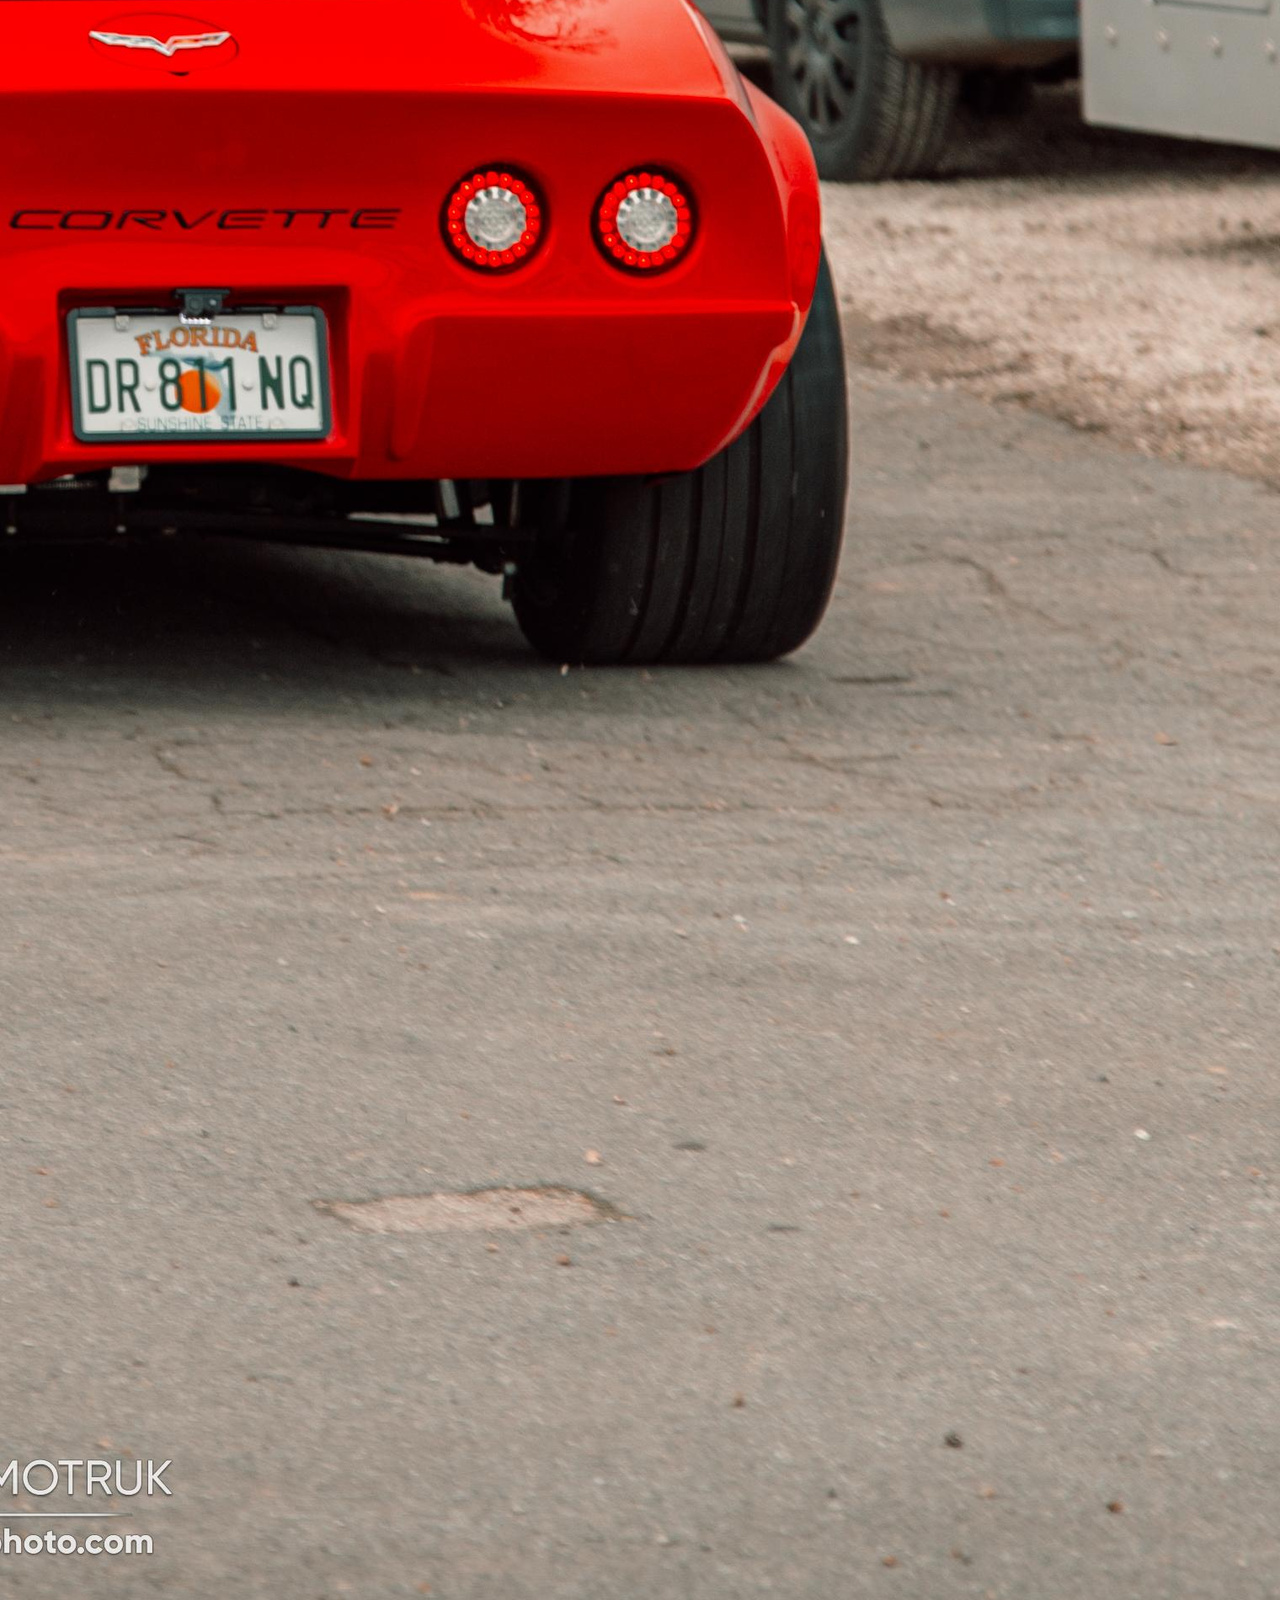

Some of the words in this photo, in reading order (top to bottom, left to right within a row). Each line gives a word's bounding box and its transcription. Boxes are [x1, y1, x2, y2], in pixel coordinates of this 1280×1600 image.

[9, 208, 402, 230] CORVETTE
[134, 325, 259, 356] FLORIDA
[86, 357, 141, 414] DR
[158, 355, 238, 413] 811
[258, 354, 315, 410] NQ
[137, 416, 211, 431] SUNSHINE
[221, 415, 263, 430] STATE
